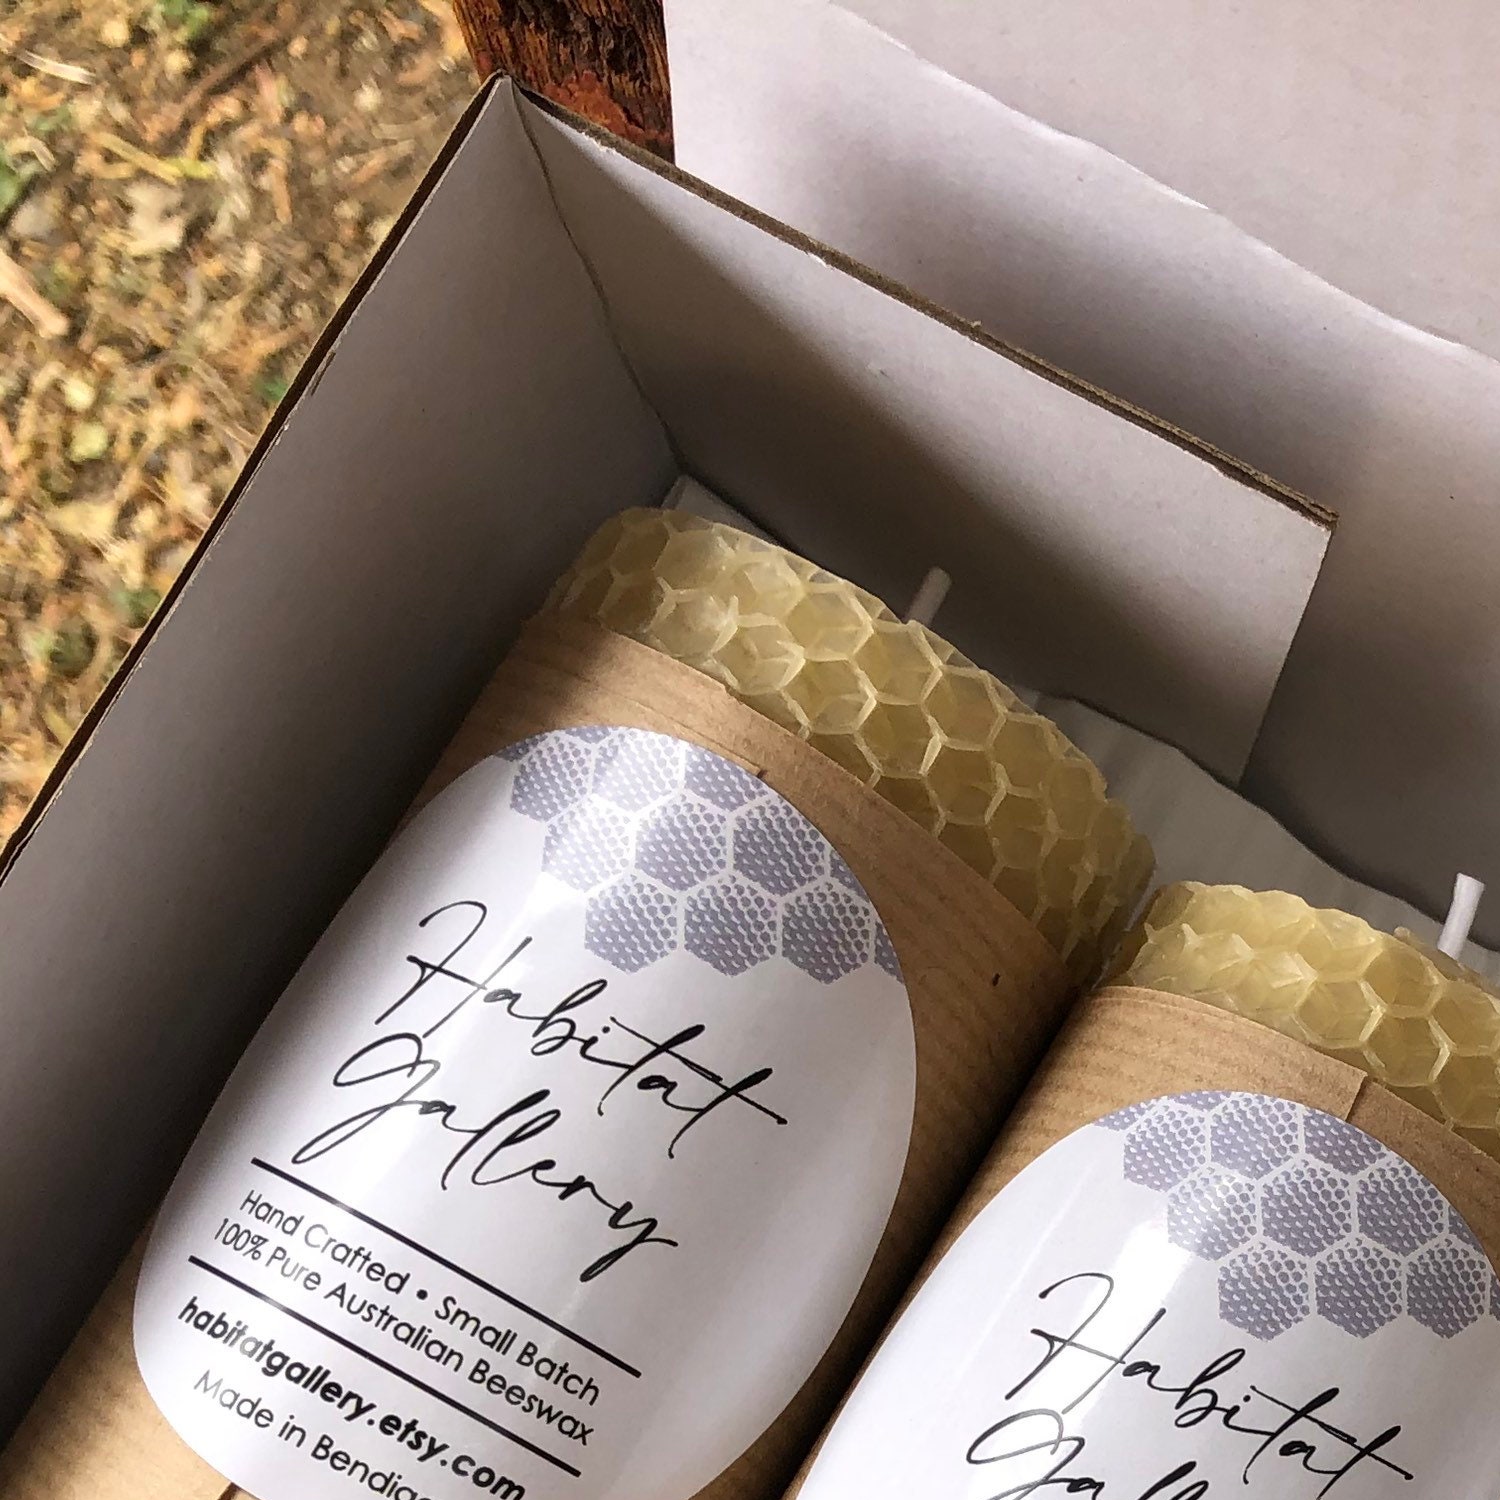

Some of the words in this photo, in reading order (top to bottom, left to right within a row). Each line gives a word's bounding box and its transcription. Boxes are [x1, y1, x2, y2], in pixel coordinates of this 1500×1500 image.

[376, 900, 787, 1159] Habitat
[291, 1033, 678, 1284] Gallery
[194, 1368, 274, 1431] Made
[278, 1414, 307, 1450] in
[213, 1218, 267, 1263] 100%
[265, 1249, 321, 1291] Pure
[324, 1282, 464, 1374] Australian
[468, 1360, 594, 1448] Beeswax
[239, 1189, 301, 1241] Hand
[304, 1223, 410, 1296] Crafted
[433, 1293, 517, 1363] Small
[518, 1350, 602, 1406] Batch
